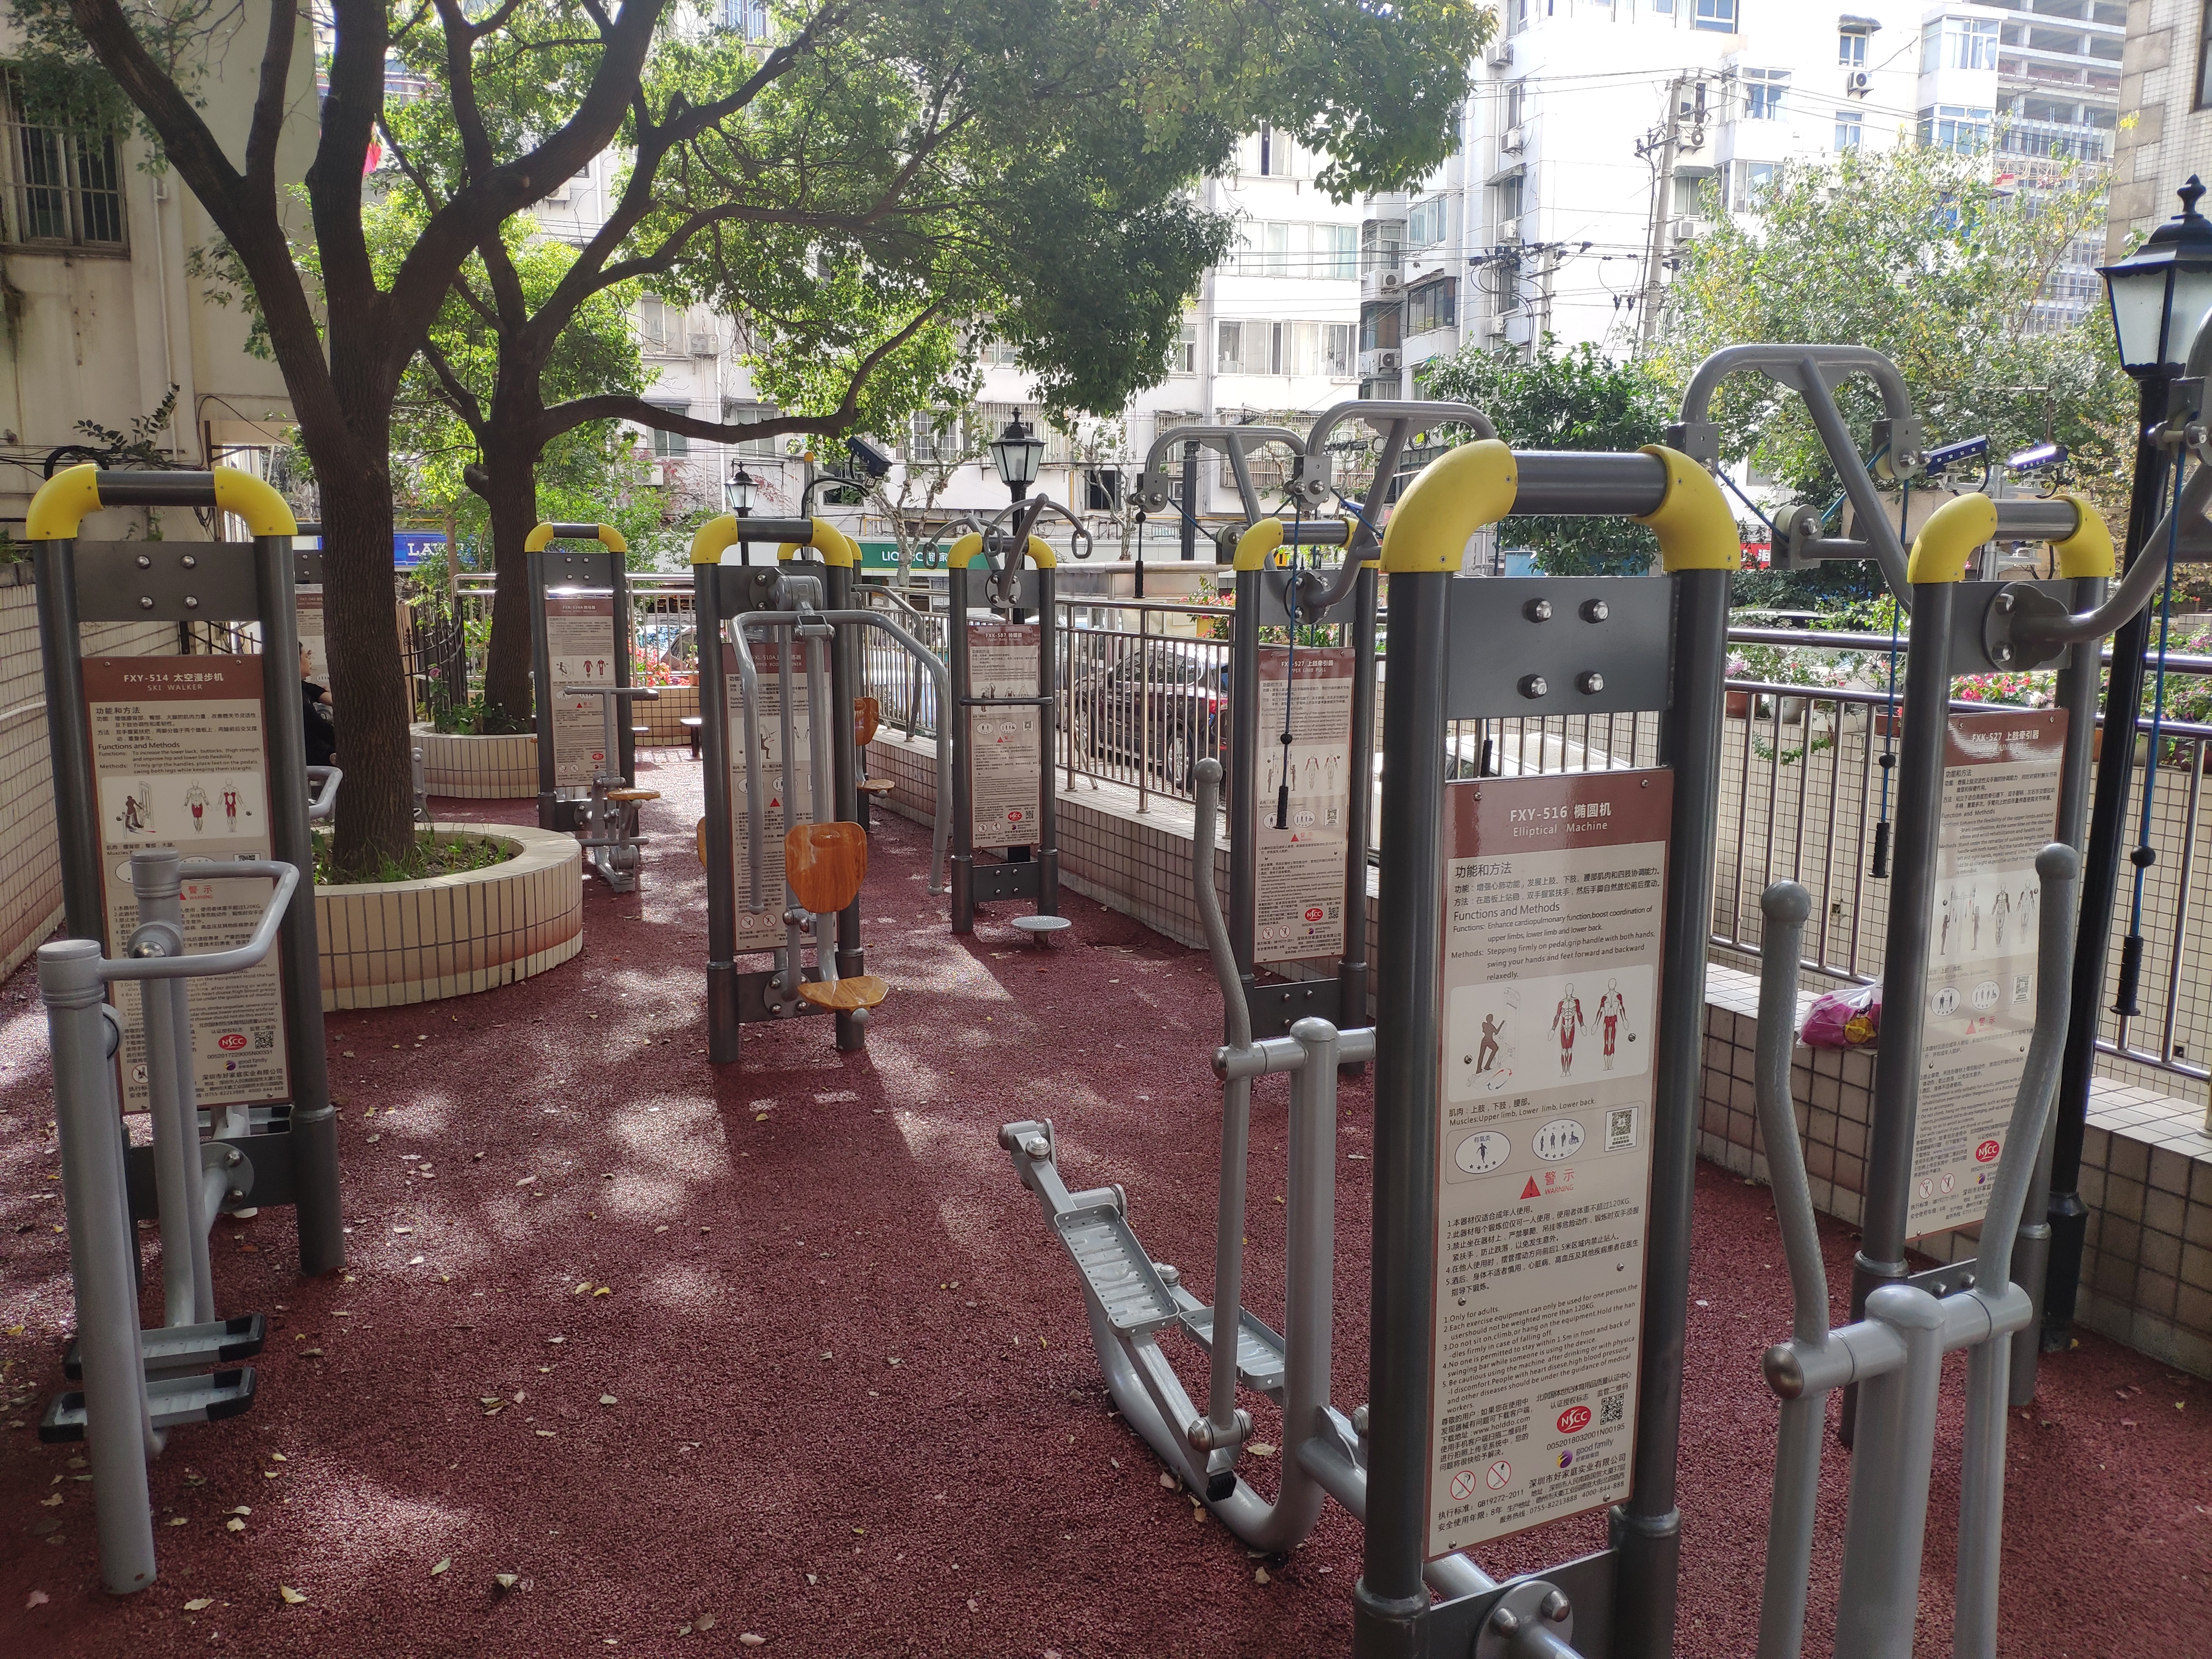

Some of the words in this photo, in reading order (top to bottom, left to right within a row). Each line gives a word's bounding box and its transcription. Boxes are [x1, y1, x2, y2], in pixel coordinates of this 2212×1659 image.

[123, 674, 169, 683] FXY-514
[173, 673, 224, 682] 太空漫步机
[95, 706, 140, 715] 功能和方法
[1510, 805, 1568, 822] FXY-516
[1573, 802, 1612, 819] 椭圆机
[1513, 824, 1558, 838] Elliptical
[1566, 821, 1608, 833] Machine
[1454, 861, 1512, 879] 功能和方法
[1453, 909, 1498, 922] Functions
[1499, 905, 1517, 917] and
[1520, 901, 1560, 915] Methods
[1487, 921, 1514, 929] Enhance
[1514, 916, 1566, 927] cardiopulmonary
[1609, 907, 1645, 917] coordination
[1646, 905, 1653, 913] of
[1487, 934, 1506, 944] upper
[1506, 932, 1525, 940] limbs,
[1558, 926, 1570, 935] and
[1451, 949, 1484, 959] Methods:
[1487, 946, 1517, 956] Stepping
[1518, 943, 1537, 952] firmly
[1582, 935, 1604, 945] handle
[1604, 934, 1618, 942] with
[1619, 932, 1634, 940] both
[1486, 960, 1507, 968] swing
[1508, 958, 1524, 967] your
[1525, 955, 1545, 963] hands
[1546, 952, 1559, 961] and
[1574, 948, 1600, 958] forward
[1600, 946, 1613, 955] and
[1614, 943, 1645, 953] backward
[1486, 970, 1519, 980] relaxedly.
[222, 1035, 244, 1047] NSCC
[1500, 1109, 1517, 1118] limb,
[1519, 1107, 1539, 1116] Lower
[1541, 1103, 1558, 1112] limb,
[1559, 1101, 1579, 1109] Lower
[1978, 1143, 1997, 1158] NSCC
[1544, 1168, 1573, 1186] 警示
[1544, 1183, 1575, 1195] WARNING
[1466, 1317, 1493, 1328] exercise
[1494, 1308, 1529, 1322] equipment
[1542, 1302, 1557, 1311] only
[1566, 1295, 1582, 1305] used
[1477, 1306, 1500, 1316] adults.
[1550, 1393, 1589, 1409] 认证授权标志
[1596, 1381, 1628, 1397] 监管二维码
[1561, 1408, 1588, 1427] NSCC
[1546, 1422, 1625, 1451] 0052018032001N00195
[1576, 1442, 1593, 1456] good
[1594, 1438, 1614, 1449] family
[1528, 1452, 1626, 1489] 深圳市好家庭实业有限公司
[1477, 1488, 1523, 1508] GB19272-2011
[1581, 1480, 1624, 1498] 4000-844-888
